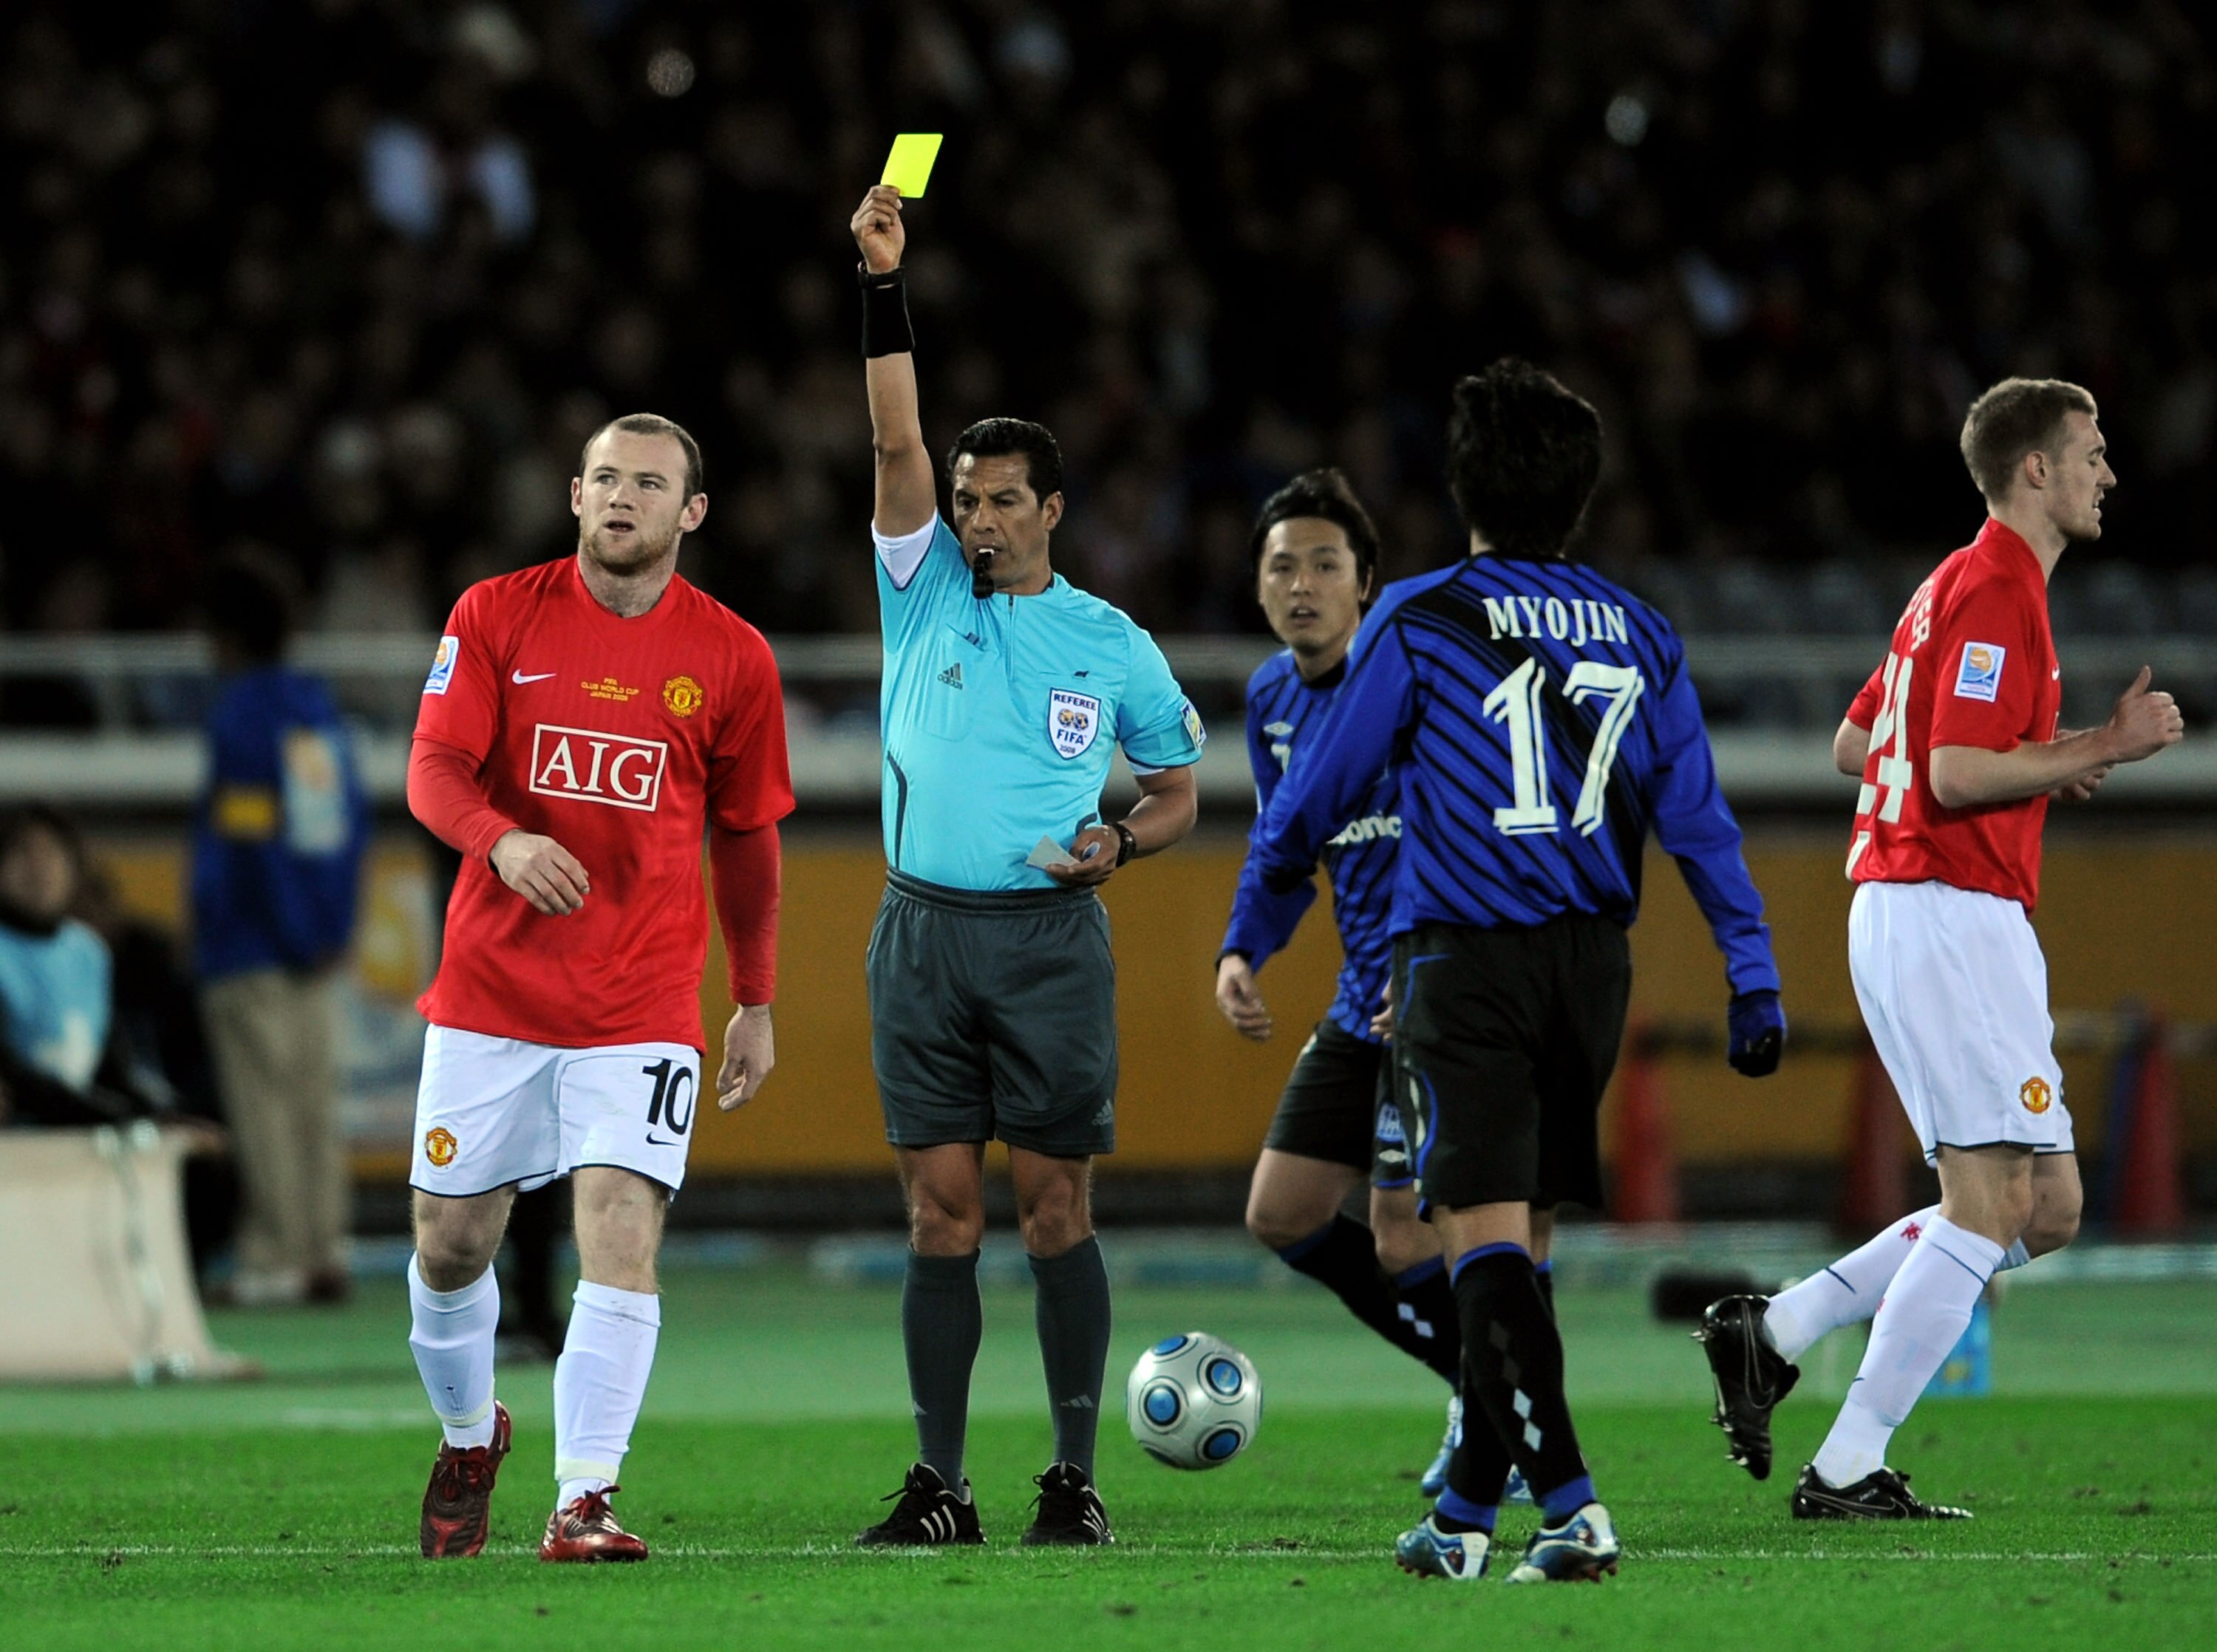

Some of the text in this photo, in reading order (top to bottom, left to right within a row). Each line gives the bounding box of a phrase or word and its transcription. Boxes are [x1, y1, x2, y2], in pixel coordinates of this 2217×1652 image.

[1482, 595, 1629, 646] MYOJIN
[937, 674, 963, 690] adidas
[1054, 694, 1096, 710] REFEREE
[1057, 728, 1084, 745] FIFA
[1482, 657, 1644, 838] 17
[537, 736, 654, 800] AIG
[642, 1059, 693, 1136] 10
